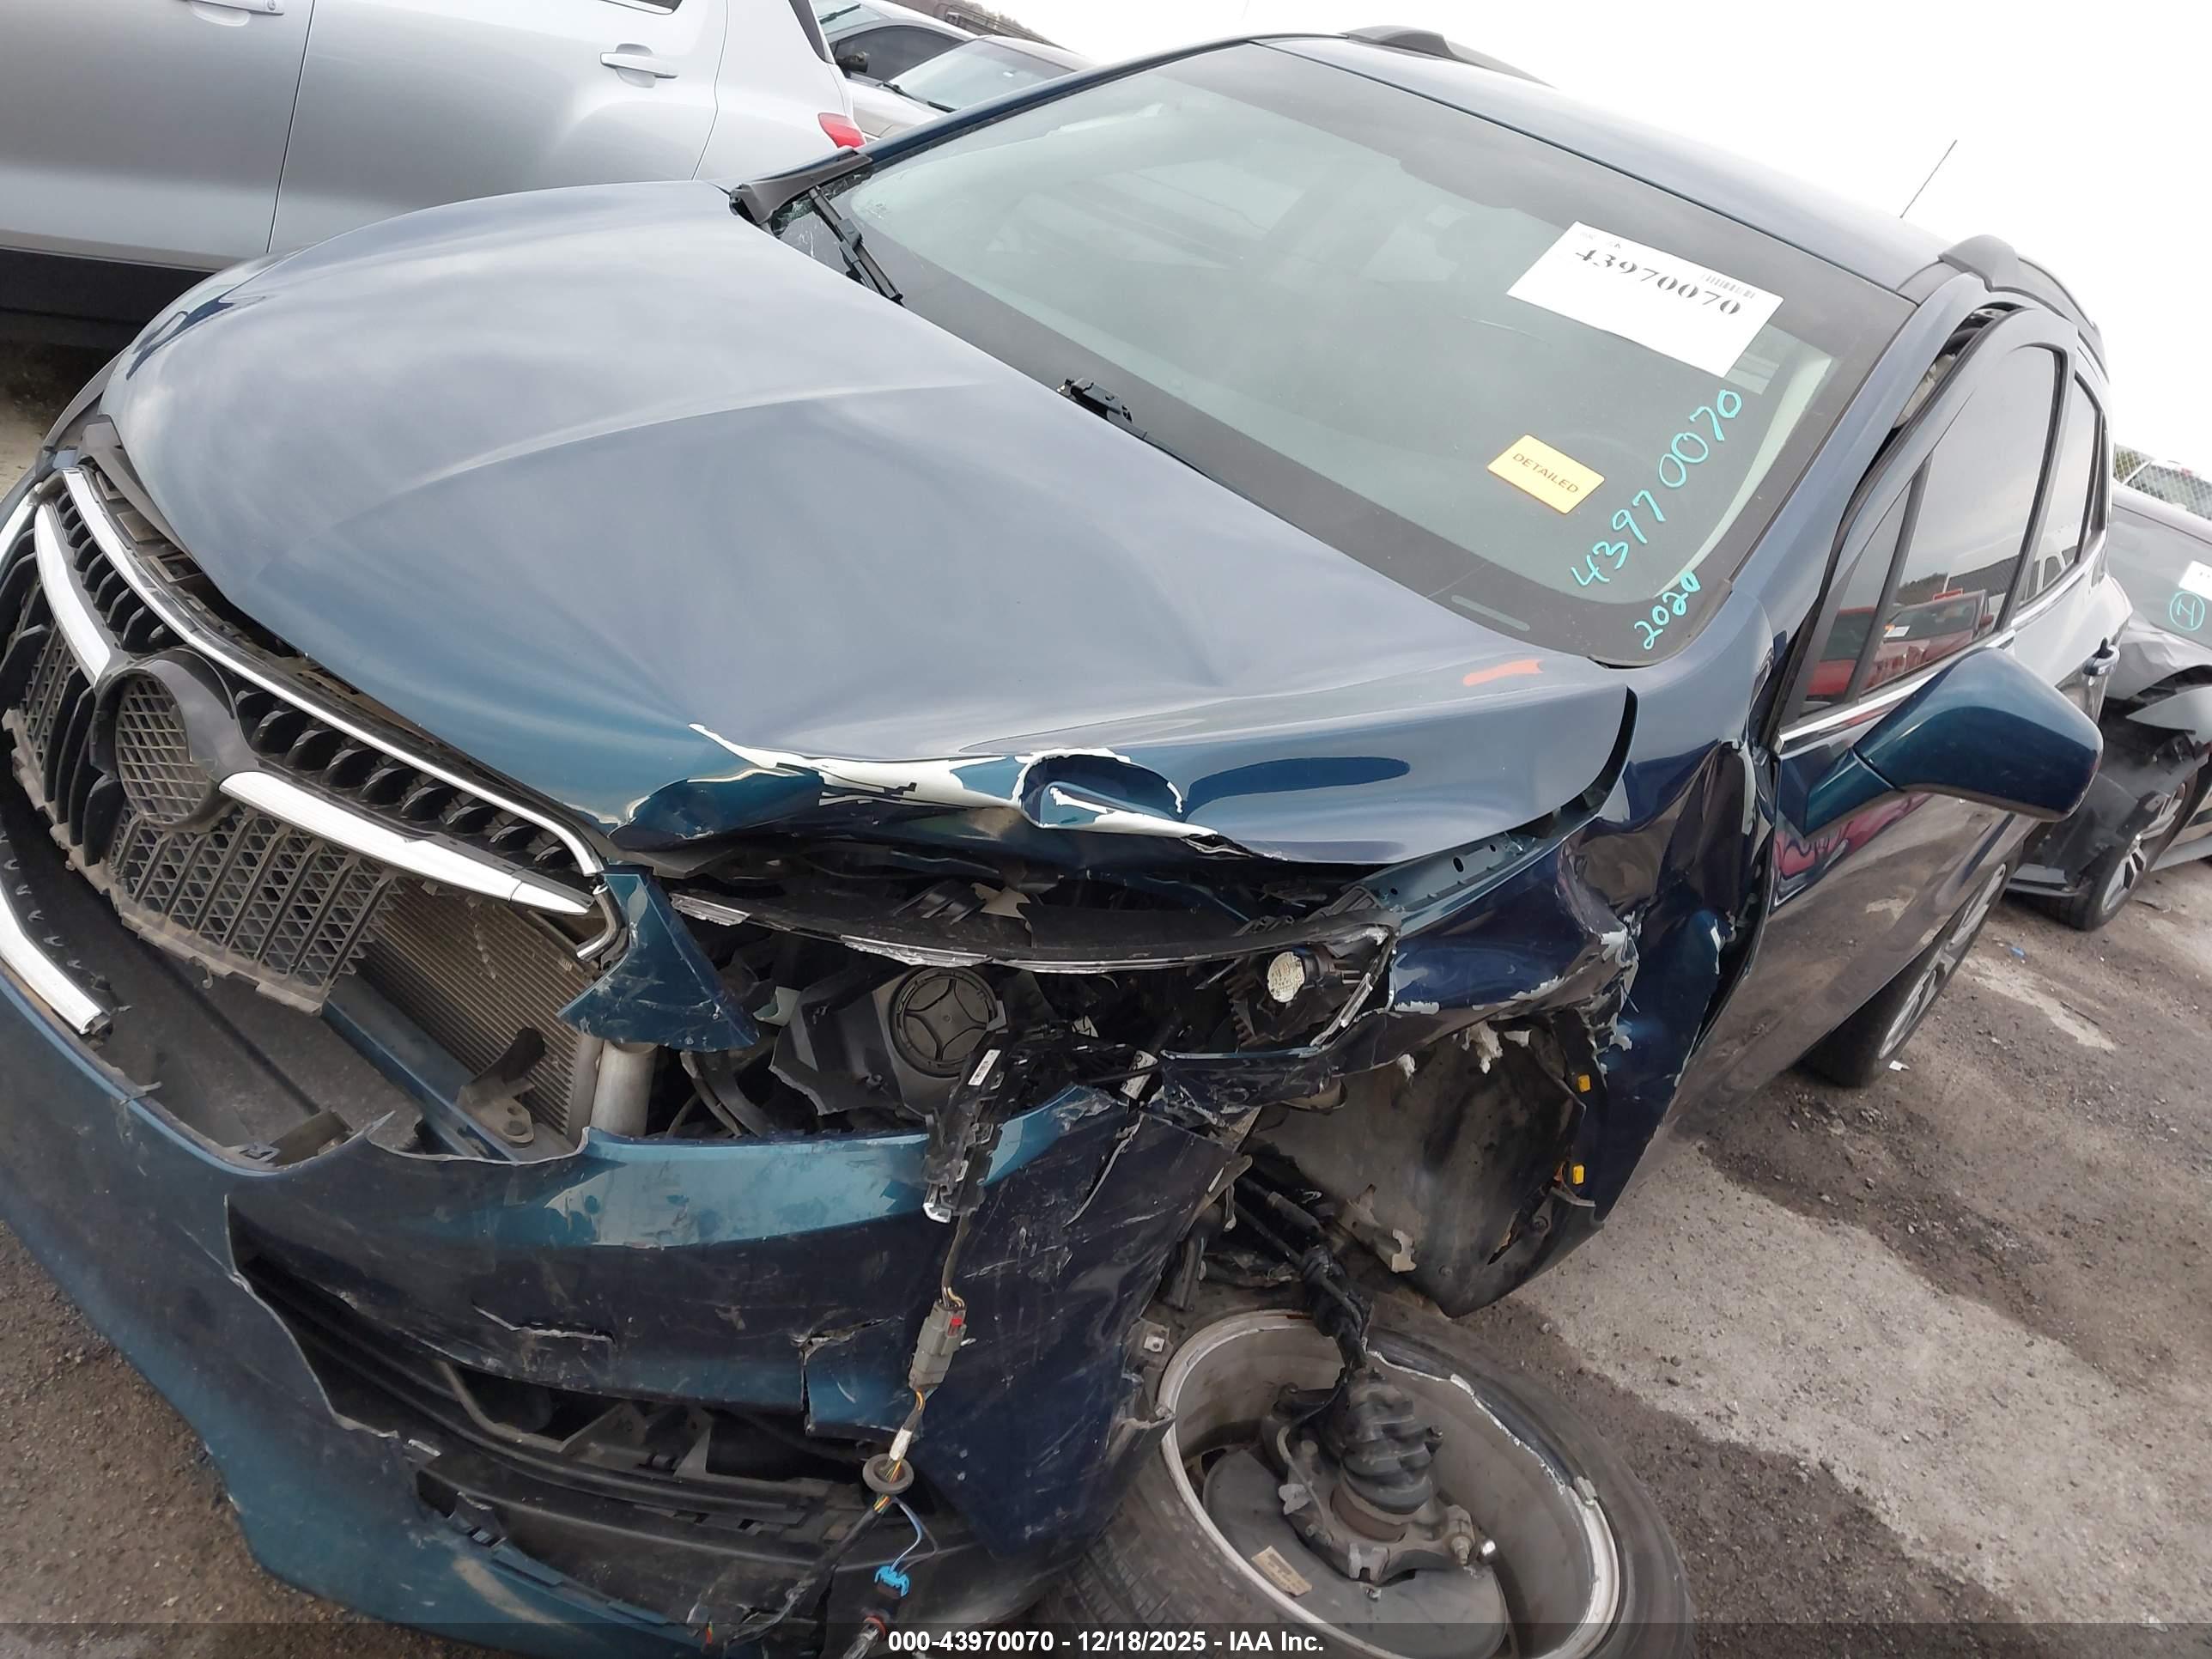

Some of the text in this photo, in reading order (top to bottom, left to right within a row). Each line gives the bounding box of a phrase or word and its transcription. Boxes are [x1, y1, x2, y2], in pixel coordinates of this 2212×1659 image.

[1575, 248, 1741, 316] 43970070
[1511, 452, 1580, 495] DETAILED
[1633, 568, 1702, 651] 2020
